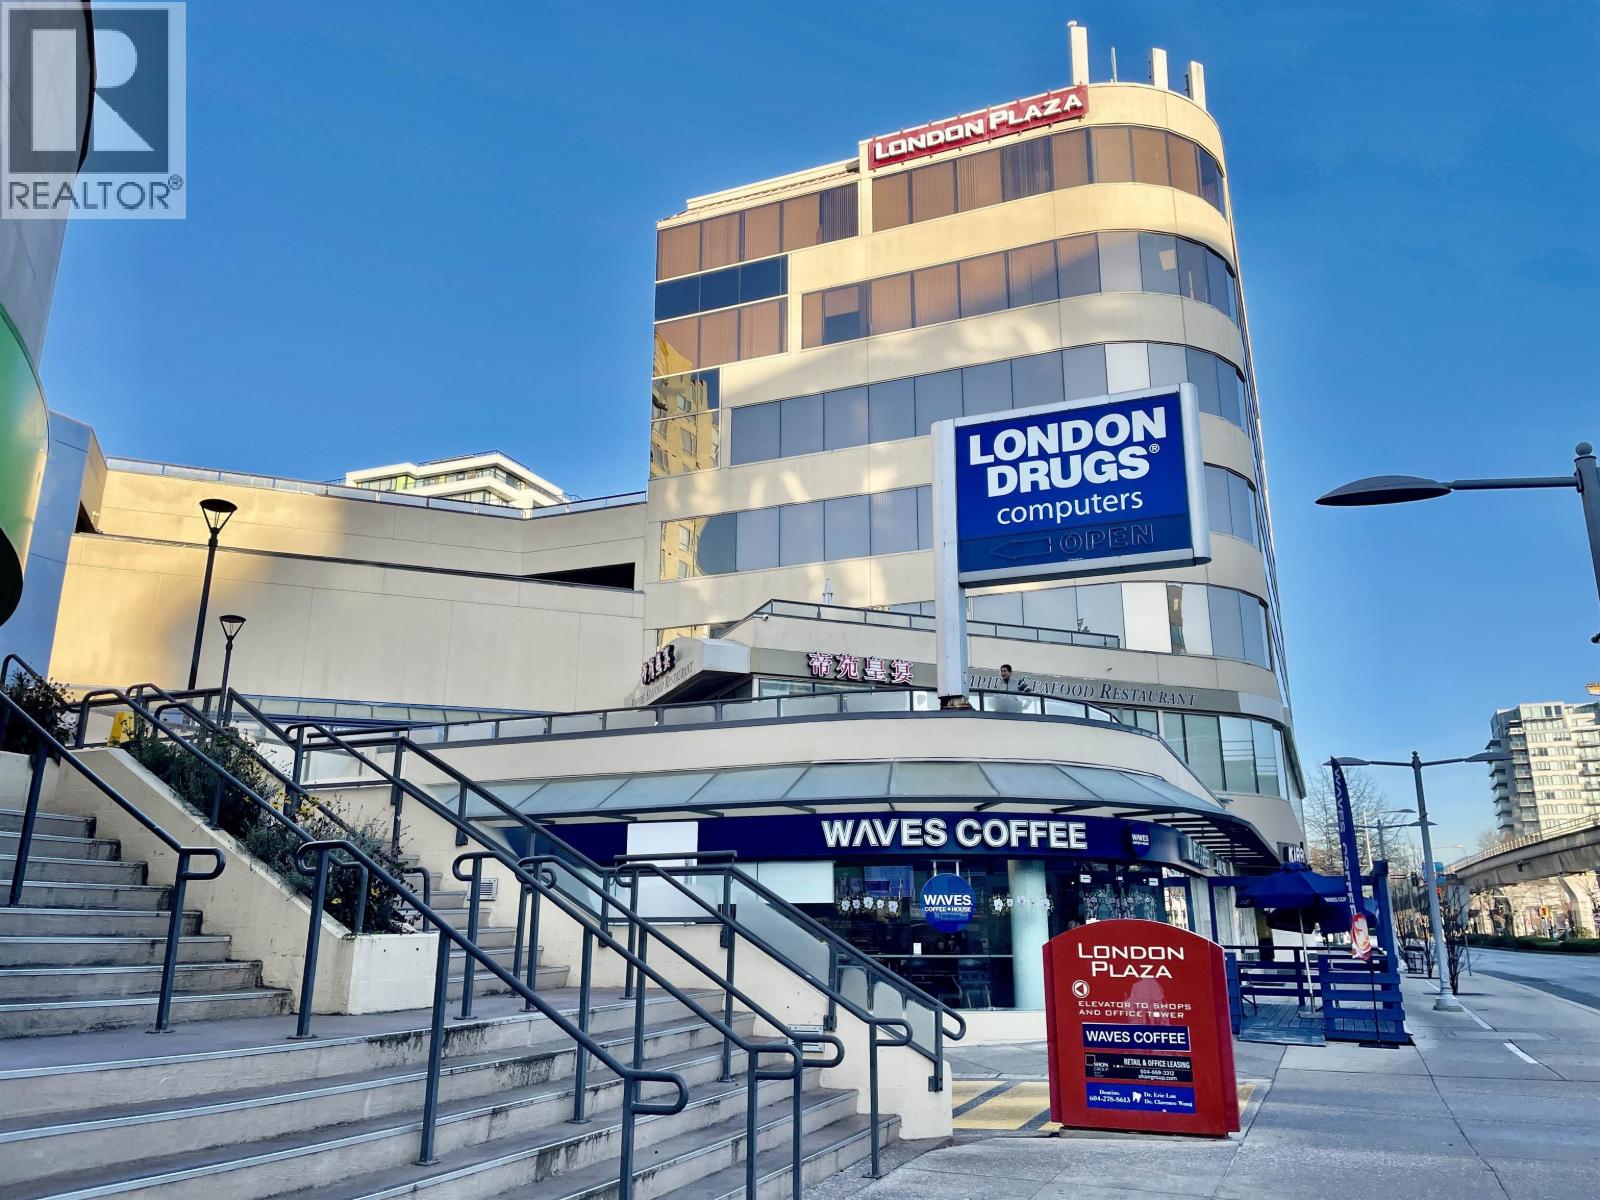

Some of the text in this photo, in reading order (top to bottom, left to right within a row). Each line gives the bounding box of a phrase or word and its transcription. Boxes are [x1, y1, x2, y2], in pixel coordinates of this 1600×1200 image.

[875, 94, 1083, 160] LONDON PLAZA
[969, 406, 1167, 466] LONDON
[996, 490, 1144, 524] computers
[1059, 523, 1154, 554] OPEN
[808, 652, 914, 684] 帝苑皇宴
[1100, 683, 1199, 706] RESTAURANT
[821, 818, 1088, 850] WAVES COFFEE
[1334, 768, 1358, 915] WAVES COFFEE
[923, 894, 972, 906] WAVES
[1078, 942, 1185, 961] LONDON
[1091, 961, 1172, 979] PLAZA
[1078, 1000, 1131, 1009] ELEVATOR
[1153, 1003, 1192, 1011] SHOPS
[1086, 1031, 1187, 1044] WAVES COFFEE
[1123, 1058, 1190, 1069] RETAIL & OFFICE LEASING
